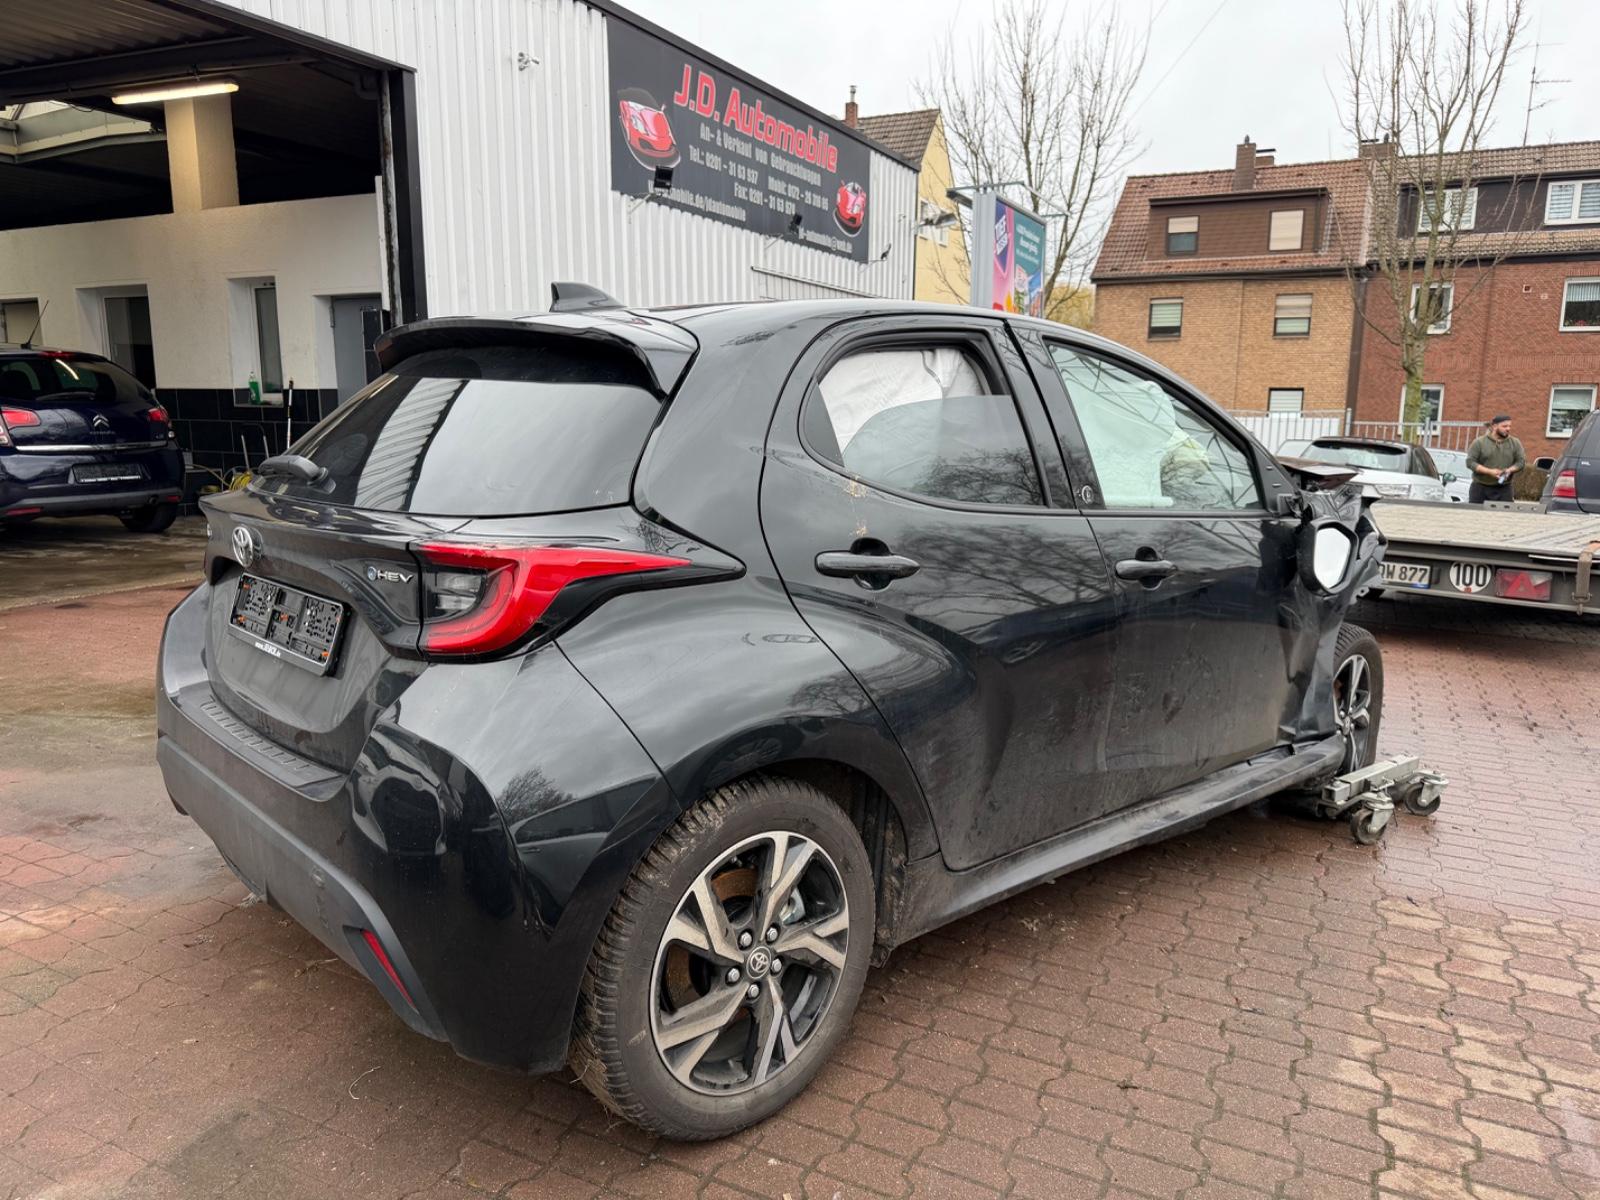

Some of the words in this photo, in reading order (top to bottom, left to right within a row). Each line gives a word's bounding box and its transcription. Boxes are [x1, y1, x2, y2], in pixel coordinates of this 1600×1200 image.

[673, 63, 720, 122] J.D.
[723, 87, 838, 174] Automobile
[700, 122, 715, 142] An-
[716, 128, 722, 148] &
[723, 131, 753, 159] Verkauf
[755, 146, 768, 166] von
[705, 151, 722, 172] 0201
[377, 569, 414, 583] HEV
[1399, 566, 1428, 582] 877
[1453, 563, 1488, 588] 100
